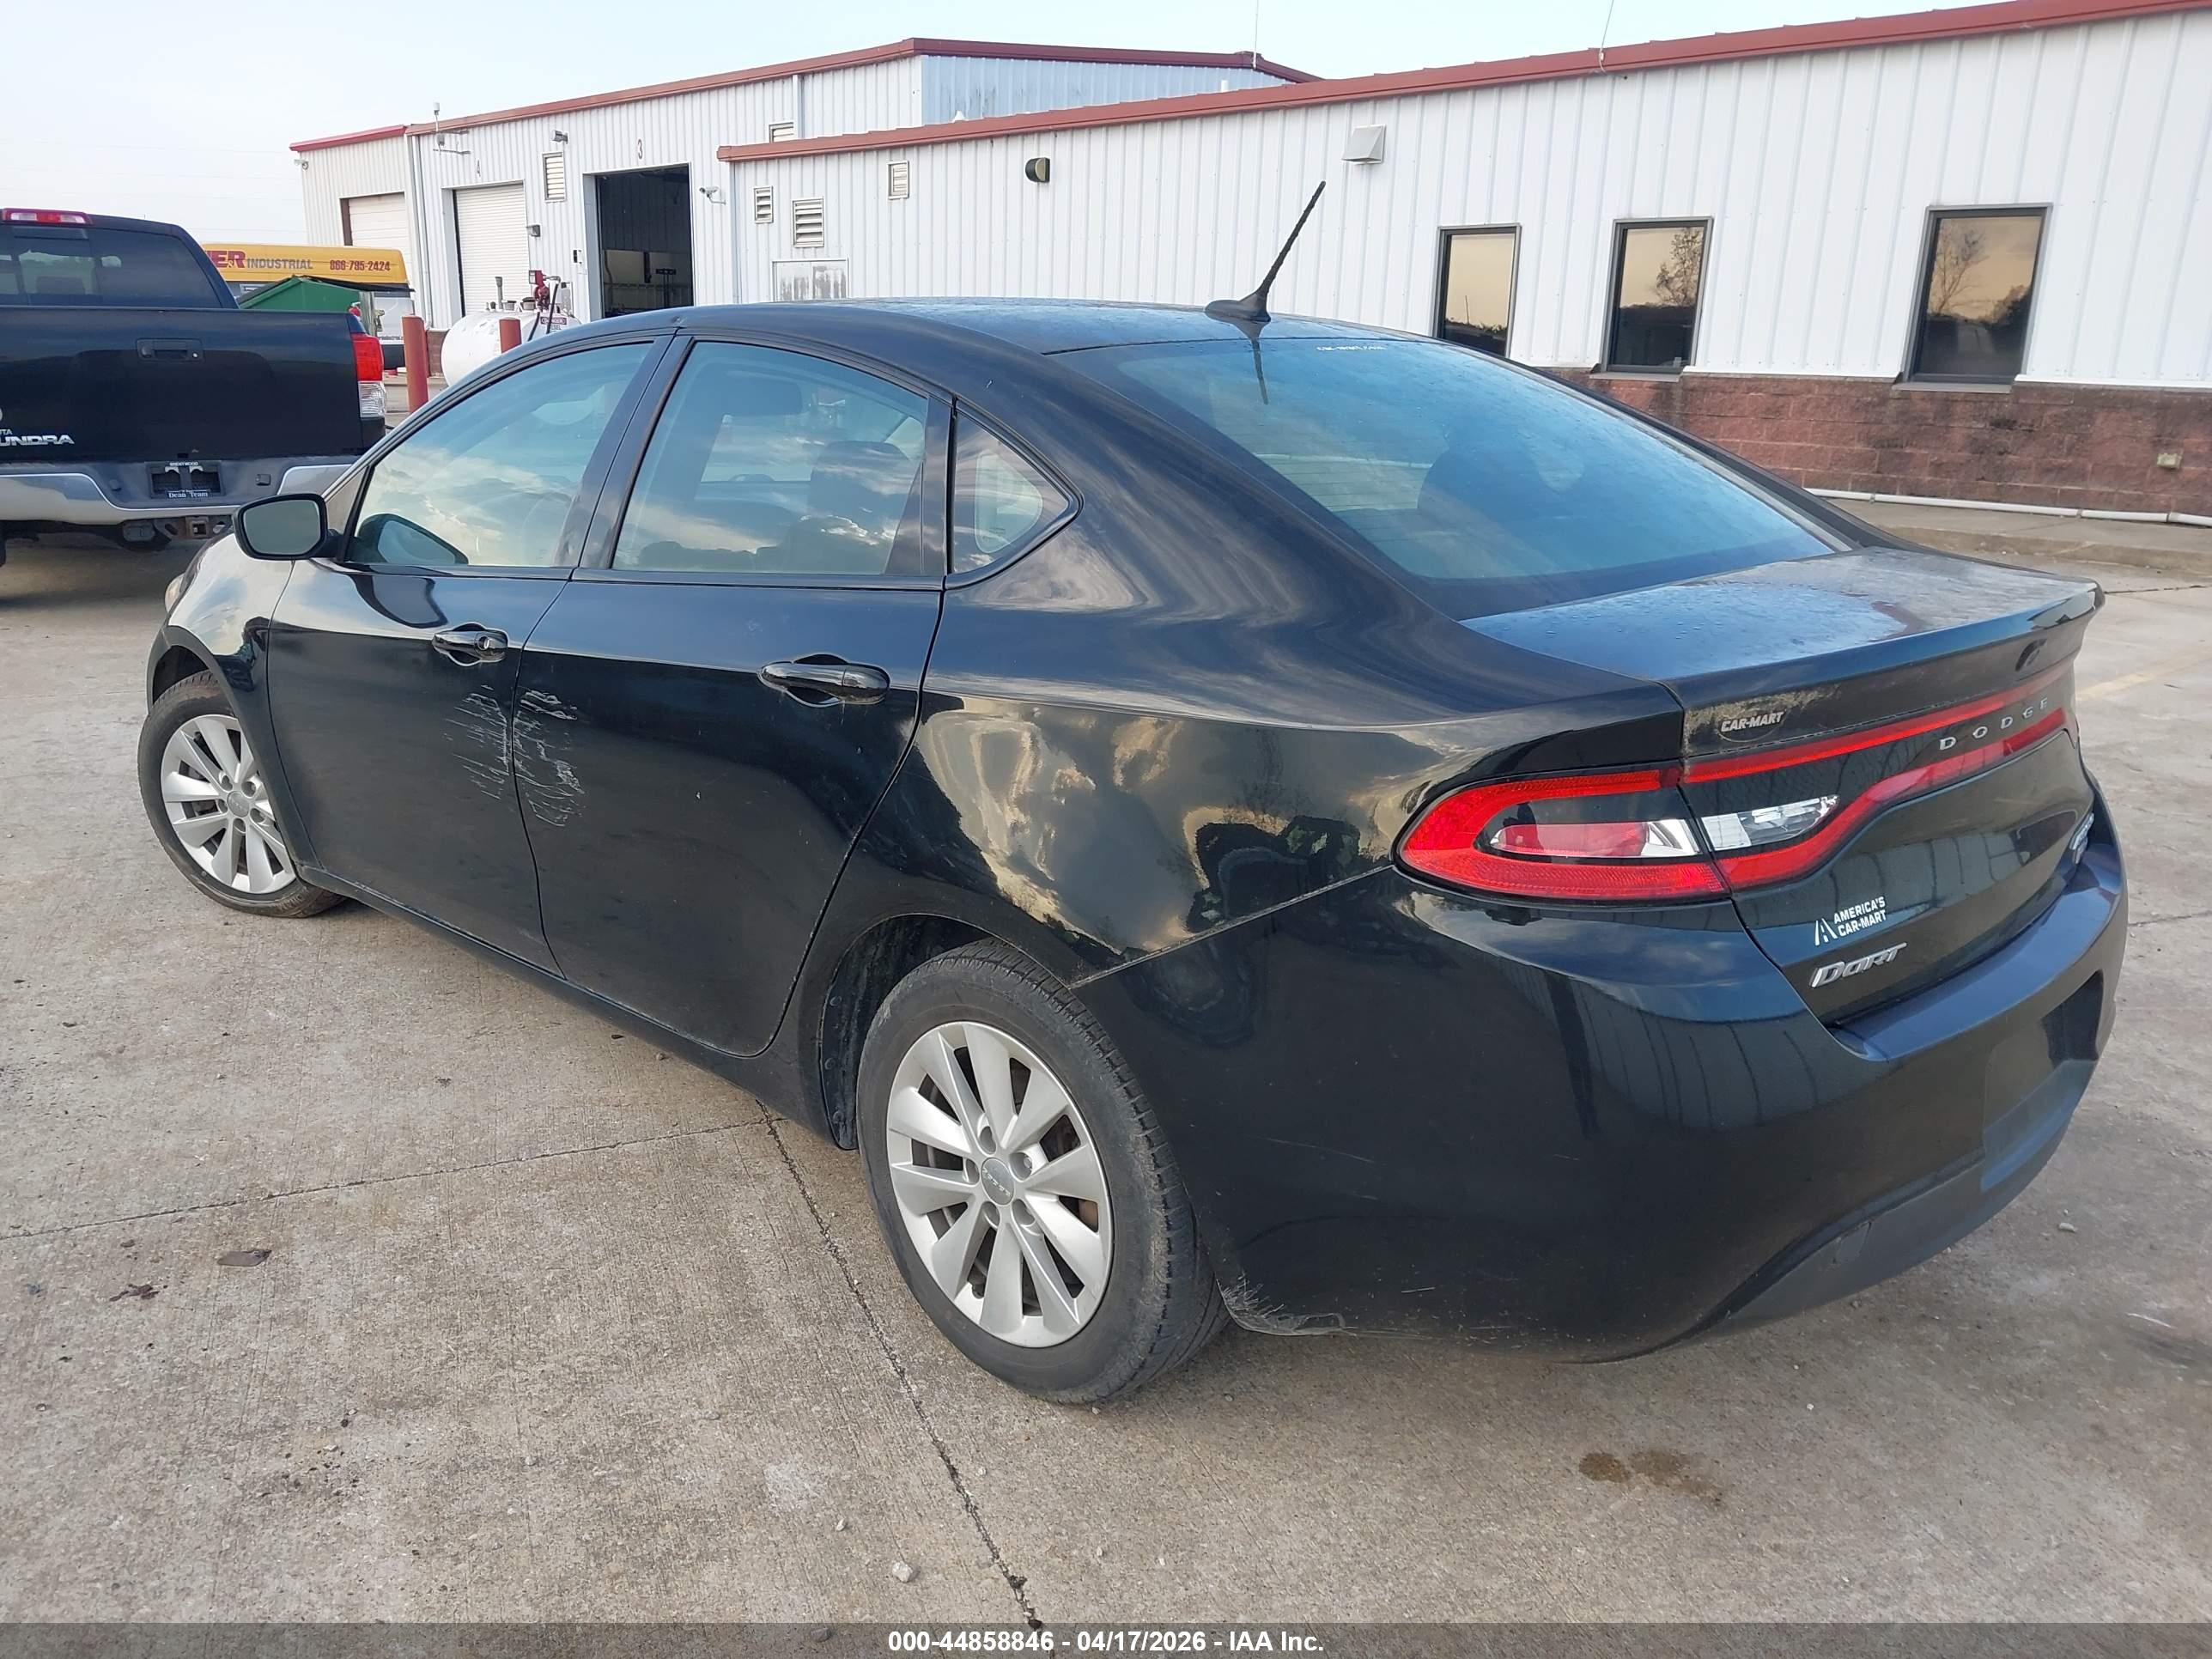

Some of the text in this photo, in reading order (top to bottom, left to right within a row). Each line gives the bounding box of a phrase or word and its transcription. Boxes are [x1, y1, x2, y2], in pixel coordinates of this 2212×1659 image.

[638, 138, 643, 160] 3
[247, 258, 313, 270] INDUSTRIAL
[330, 260, 391, 271] 866-795-2424
[1721, 711, 1784, 732] CAR-MART
[1939, 697, 2048, 750] DODGE
[1833, 896, 1886, 924] AMERICA'S
[1838, 909, 1887, 937] CAR-MART
